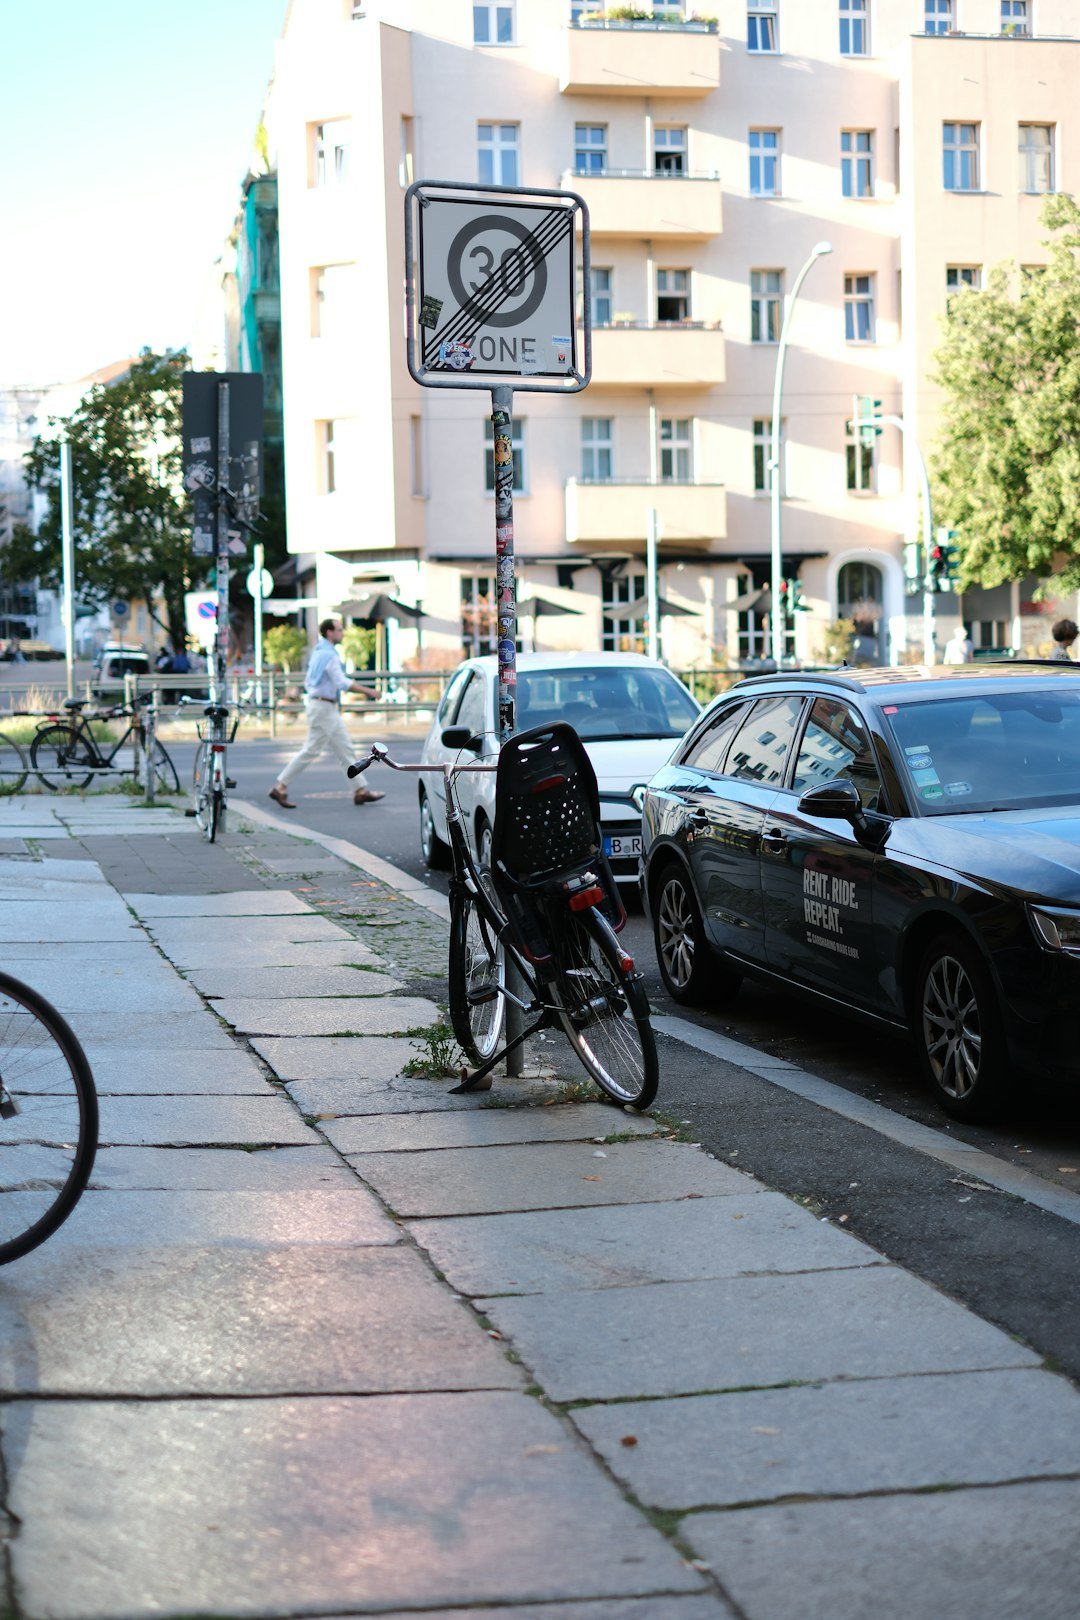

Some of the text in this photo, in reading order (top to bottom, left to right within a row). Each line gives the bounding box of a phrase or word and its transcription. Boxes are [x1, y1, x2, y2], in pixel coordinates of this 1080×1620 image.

[469, 245, 526, 298] 30
[612, 839, 622, 853] B
[803, 868, 859, 910] RENT. RIDE.
[803, 898, 843, 934] REPEAT.
